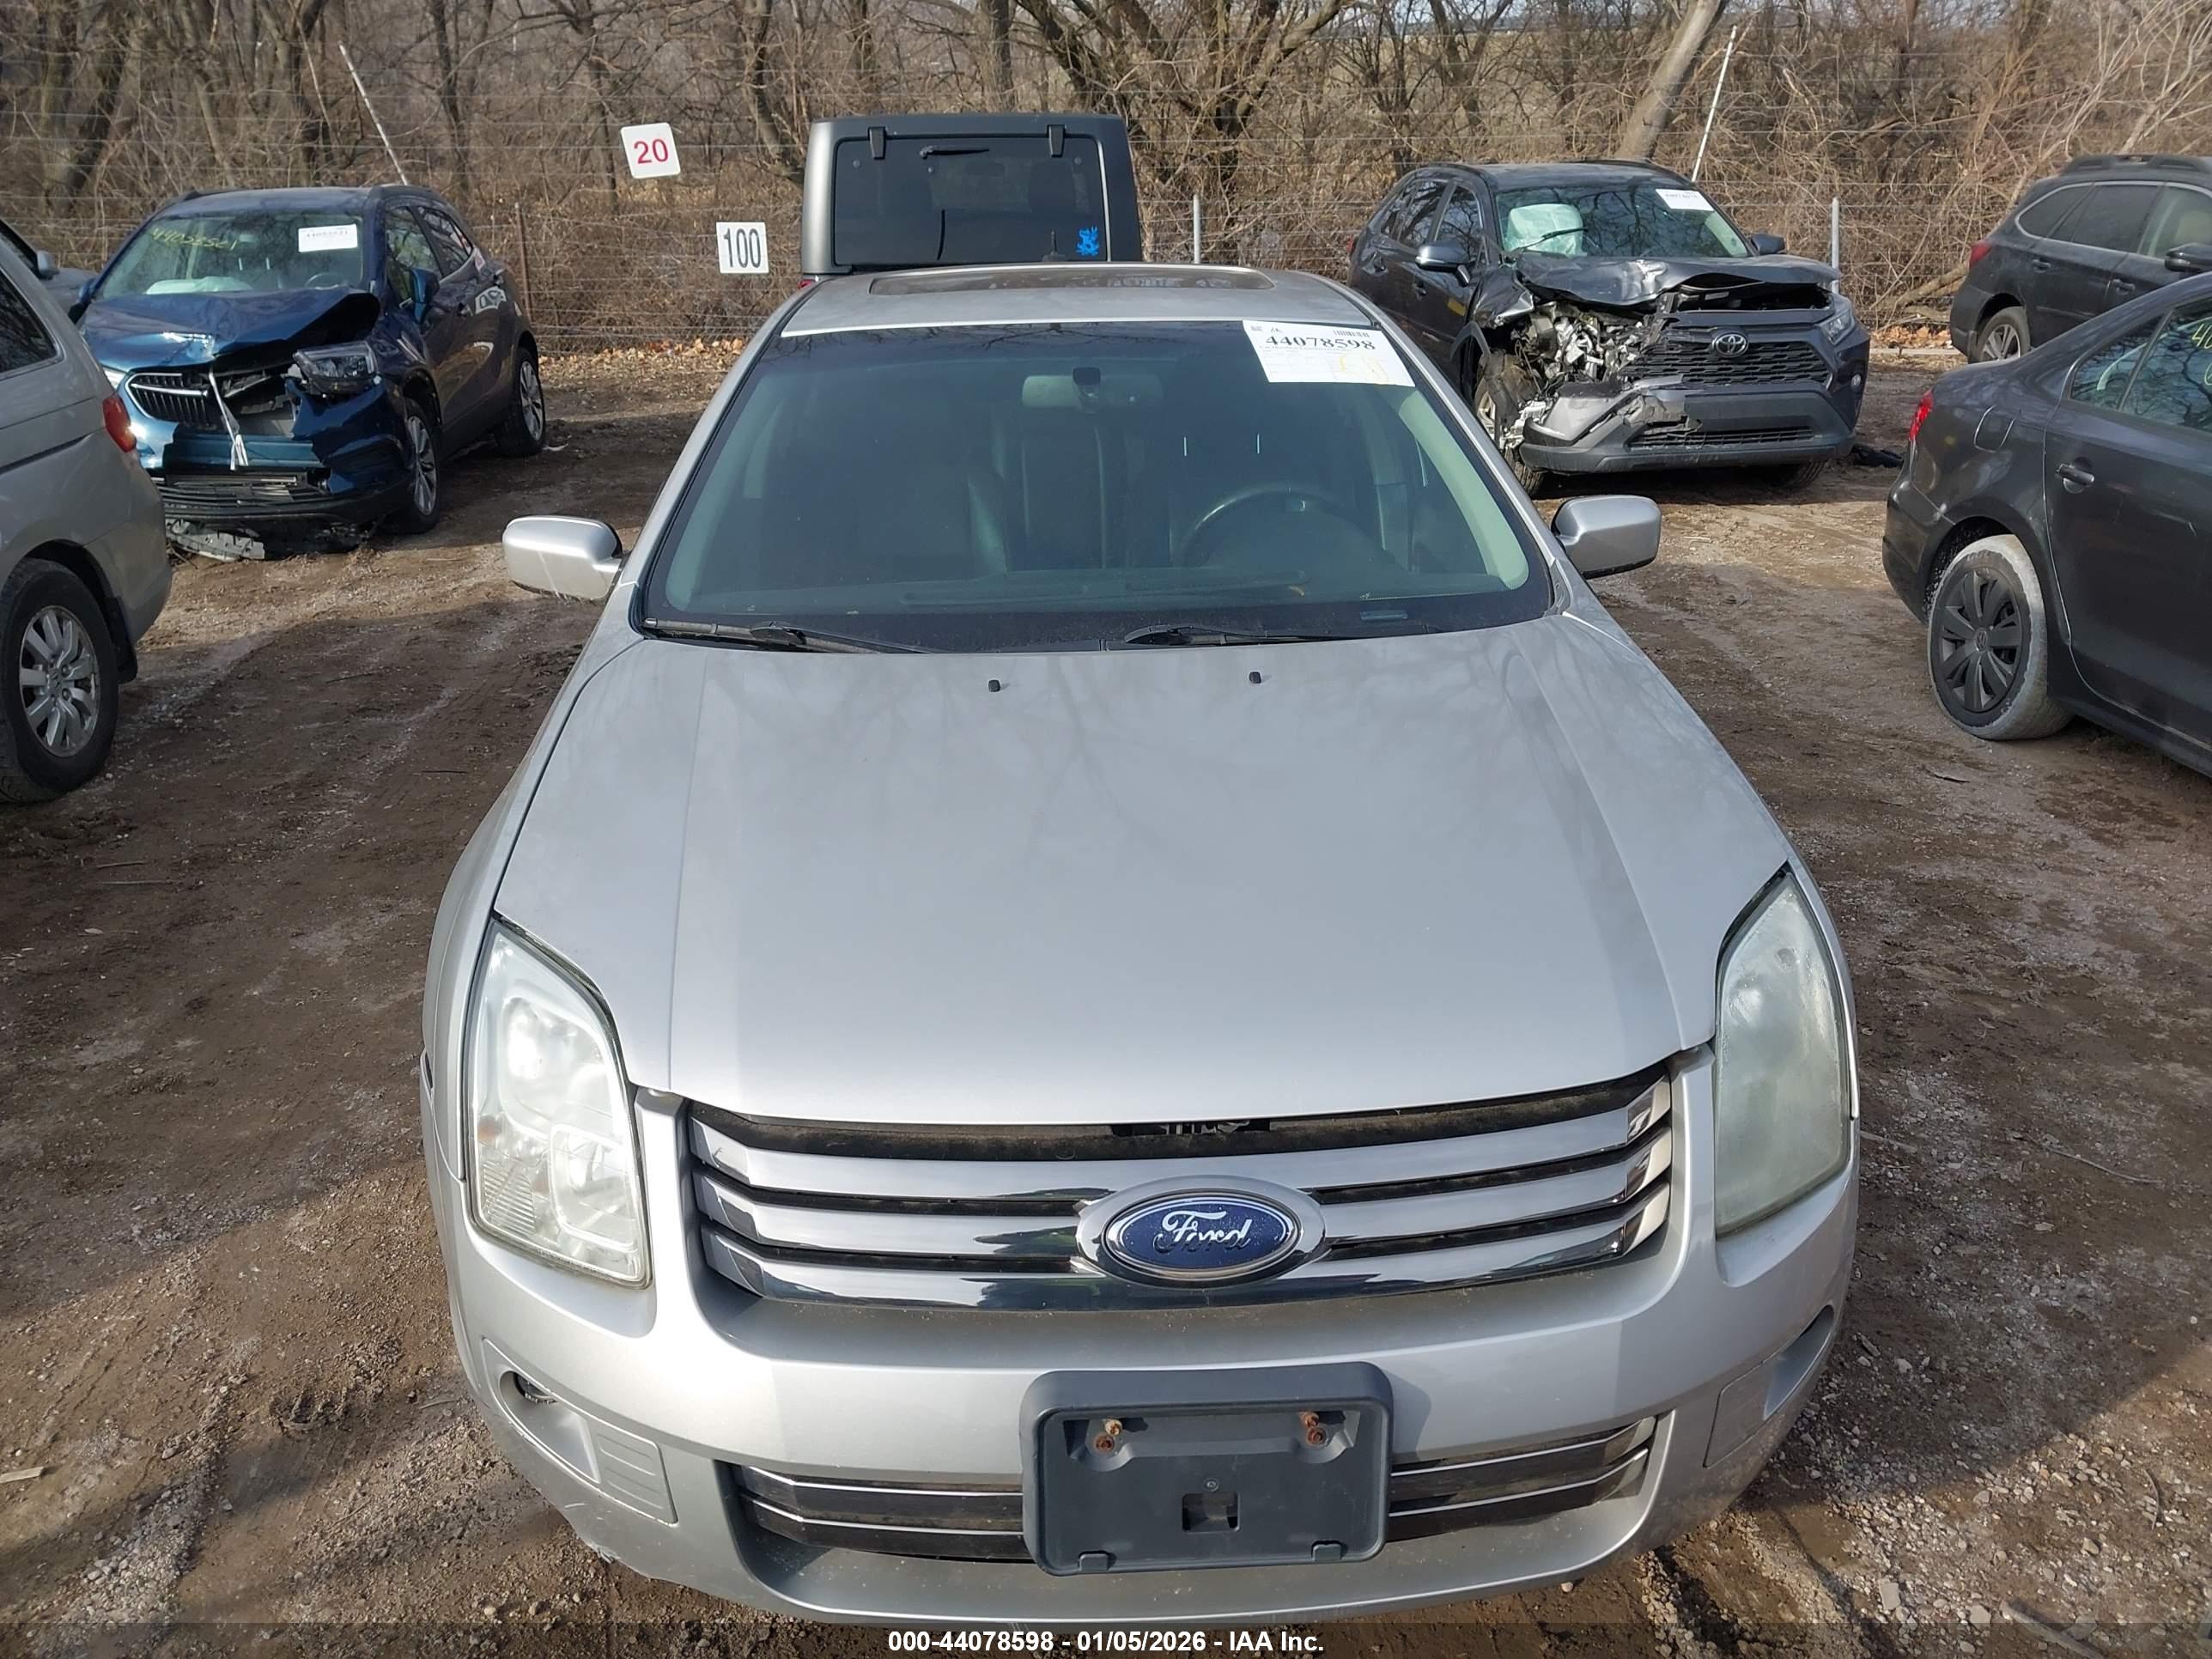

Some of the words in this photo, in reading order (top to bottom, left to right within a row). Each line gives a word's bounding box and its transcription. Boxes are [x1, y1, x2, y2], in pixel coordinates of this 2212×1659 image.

[633, 137, 669, 164] 20
[724, 228, 762, 268] 100
[1265, 335, 1376, 351] 44078598
[1153, 1210, 1253, 1254] Ford
